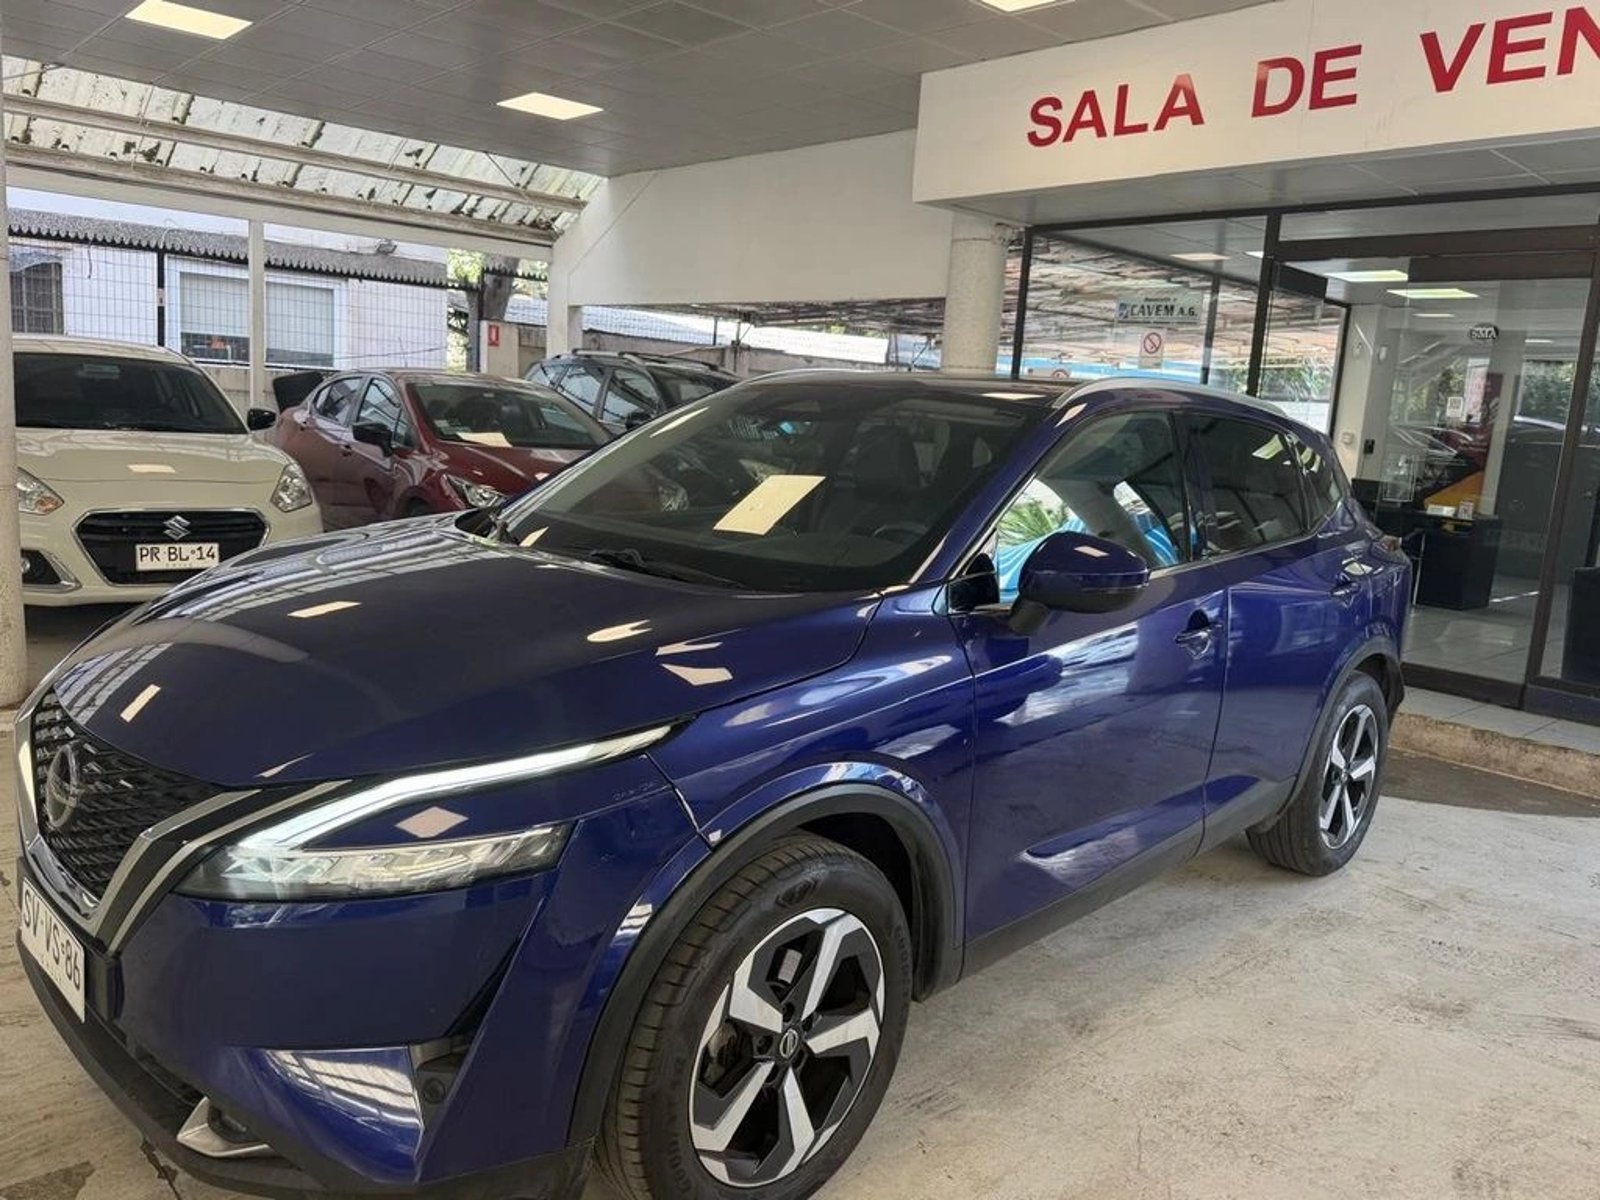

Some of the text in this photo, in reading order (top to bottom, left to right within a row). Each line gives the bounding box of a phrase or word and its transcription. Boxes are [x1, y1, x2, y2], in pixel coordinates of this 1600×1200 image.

[1027, 7, 1600, 148] SALA DE VEN
[1130, 304, 1175, 317] CAVEM
